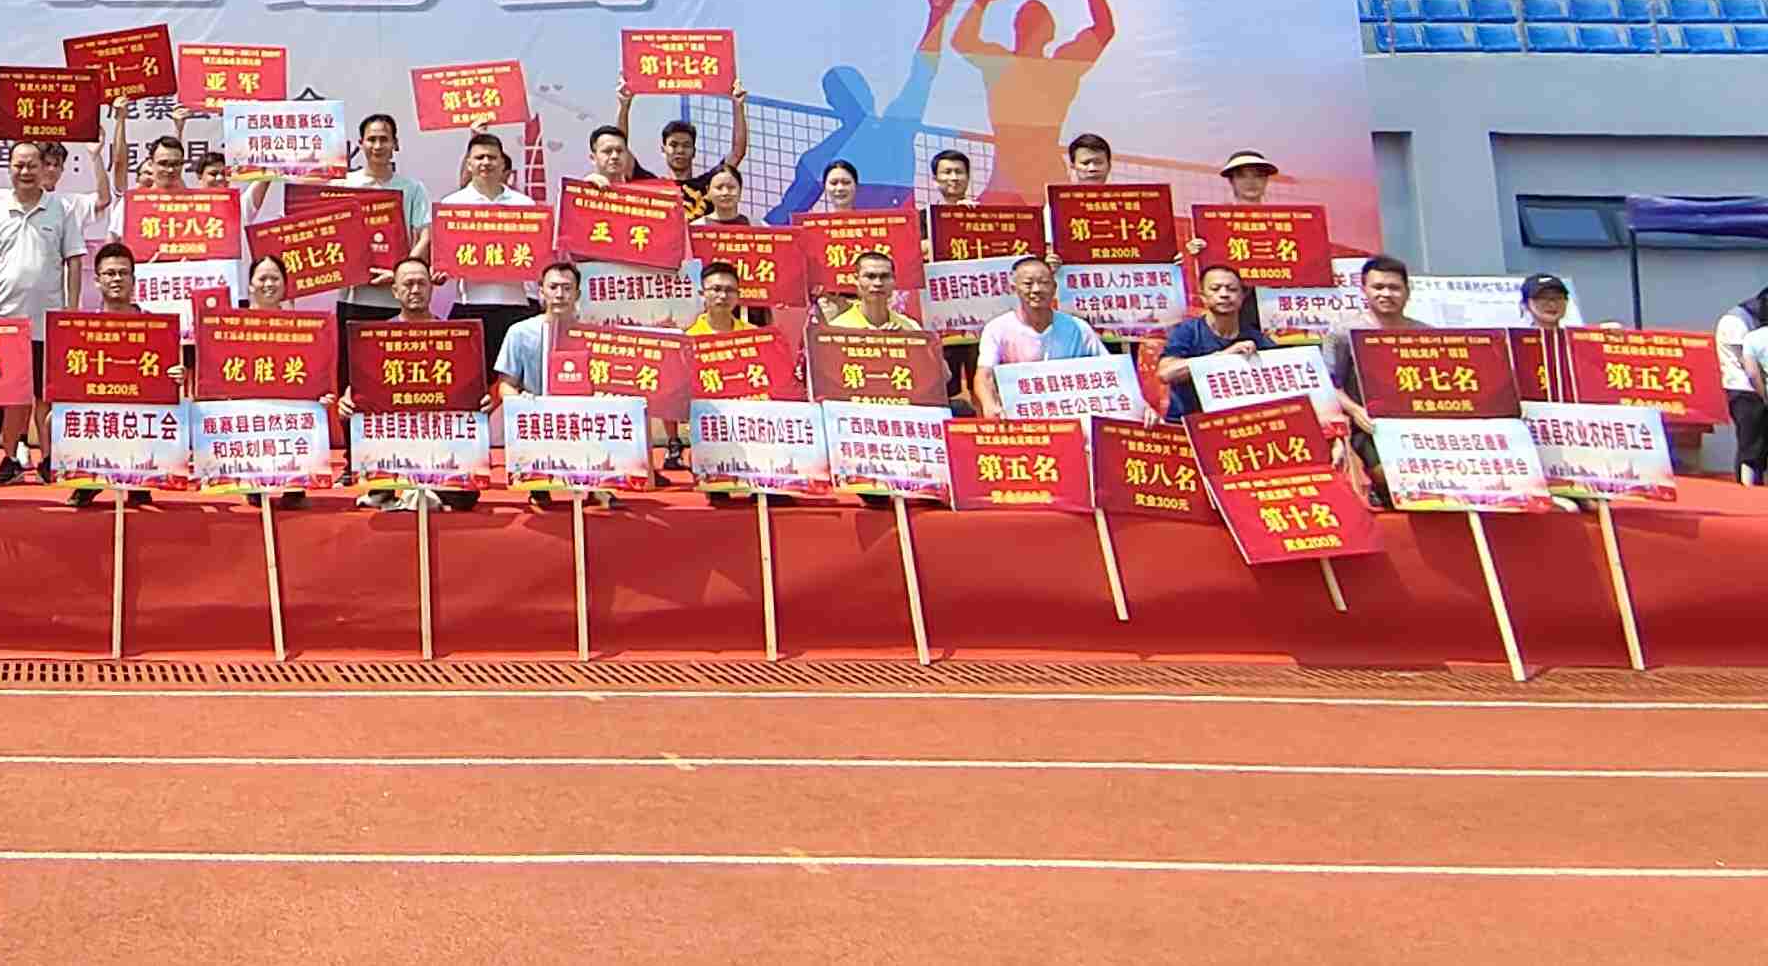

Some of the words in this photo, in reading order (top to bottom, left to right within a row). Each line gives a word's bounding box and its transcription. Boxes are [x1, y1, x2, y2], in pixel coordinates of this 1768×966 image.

[640, 55, 719, 76] 第十七名
[204, 72, 260, 94] 亚军
[16, 98, 74, 119] 第十名
[442, 88, 501, 111] 第七名
[248, 135, 322, 152] 有限公司工会
[140, 218, 224, 239] 第十八名
[590, 225, 652, 250] 亚军
[1069, 217, 1157, 242] 第二十名
[282, 244, 344, 273] 第七名
[455, 243, 534, 267] 优胜奖
[1227, 237, 1298, 262] 第三名
[1065, 272, 1172, 289] 鹿寨县人力资源和
[1074, 295, 1169, 311] 社会保障局工会
[66, 350, 160, 376] 第十一名
[223, 357, 307, 383] 优胜奖
[382, 359, 453, 386] 第五名
[589, 359, 659, 391] 第二名
[699, 364, 770, 393] 第一名
[841, 363, 913, 390] 第一名
[1395, 366, 1479, 393] 第七名
[1605, 363, 1694, 393] 第五名
[86, 384, 139, 396] 奖金200元
[1016, 394, 1131, 416] 有限责任公司工会
[63, 410, 178, 441] 鹿寨镇总工会
[203, 413, 317, 434] 鹿寨县自然资源
[517, 413, 632, 442] 鹿寨县鹿寨中学工会
[701, 415, 813, 445] 鹿寨县人民政府办公室工会
[213, 437, 309, 459] 和规划局工会
[840, 442, 945, 464] 有限责任公司工会
[1218, 437, 1313, 475] 第十八名
[977, 454, 1059, 482] 第五名
[1124, 458, 1197, 492] 第八名
[1260, 503, 1339, 533] 第十名
